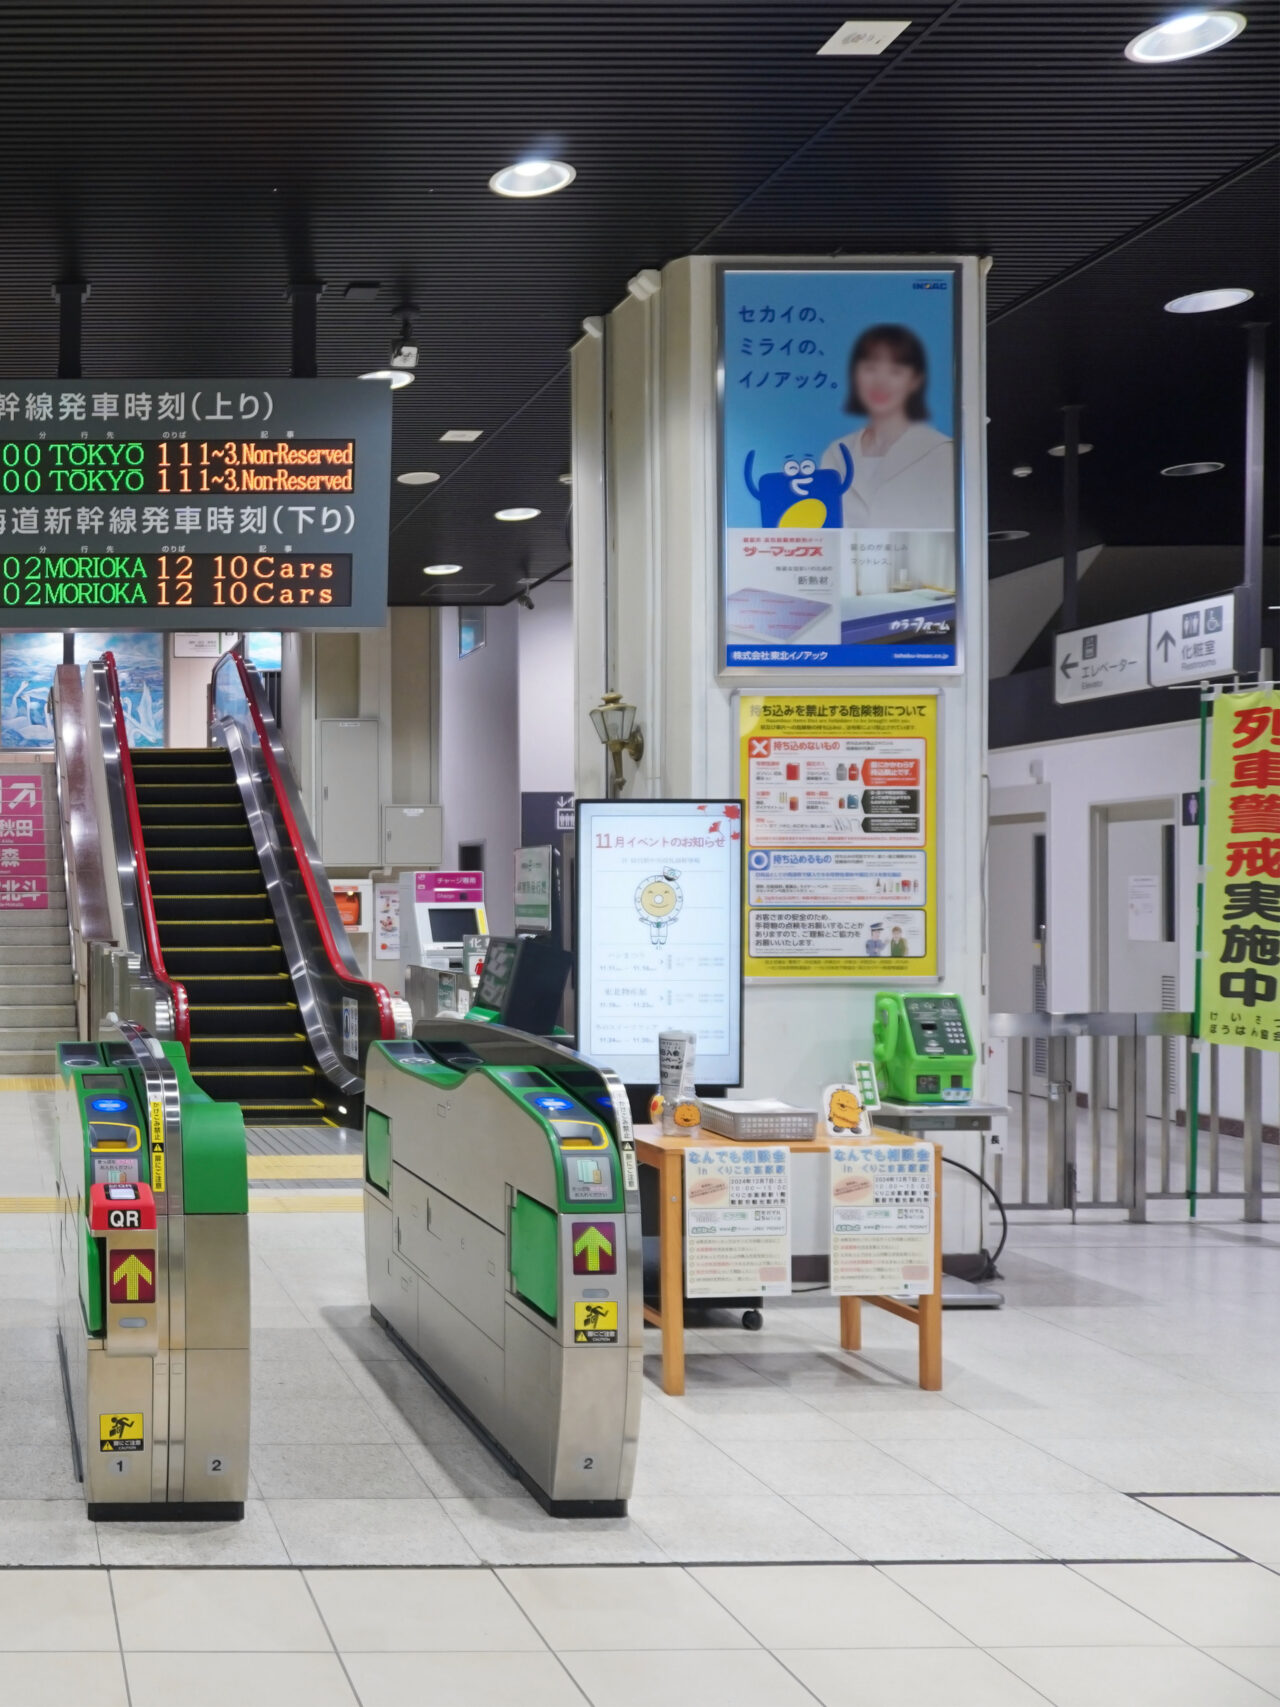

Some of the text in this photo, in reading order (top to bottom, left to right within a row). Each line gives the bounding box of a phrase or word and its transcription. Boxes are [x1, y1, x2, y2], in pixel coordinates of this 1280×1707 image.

[739, 305, 825, 323] セカイの、
[740, 338, 825, 356] ミライの、
[739, 371, 838, 390] イノアック。
[45, 557, 148, 579] MORIOKA
[157, 556, 193, 579] 12
[45, 583, 148, 604] MORIOKA
[157, 582, 193, 605] 12
[1181, 640, 1216, 660] 化粧室
[1082, 658, 1138, 679] エレベーター
[110, 1211, 140, 1228] QR
[116, 1460, 122, 1472] 1
[212, 1460, 222, 1471] 2
[584, 1458, 594, 1470] 2
